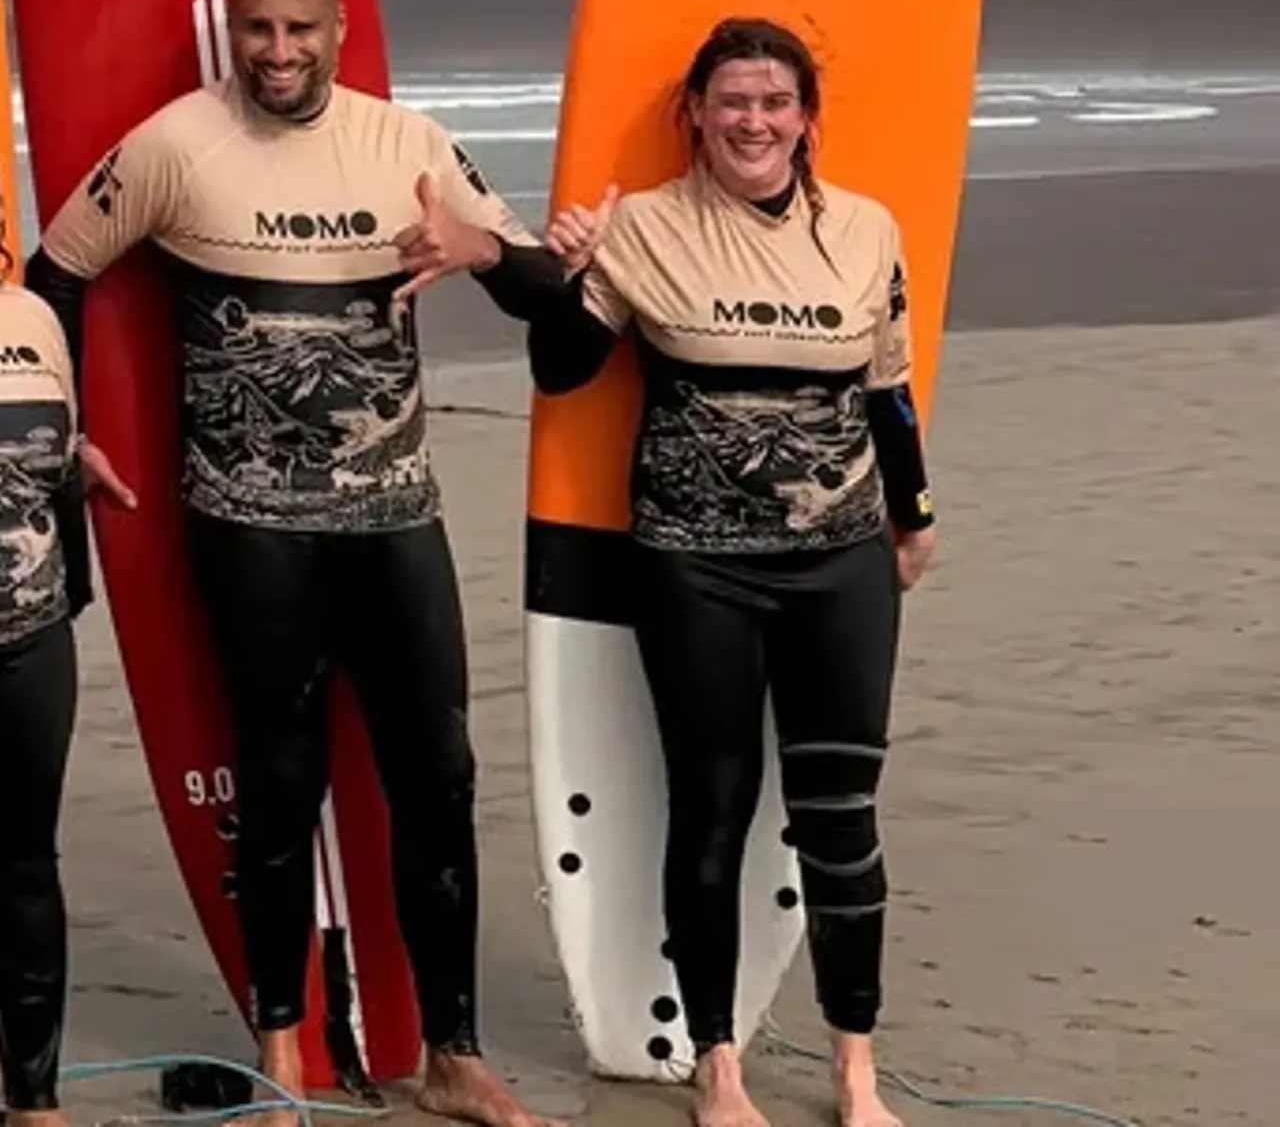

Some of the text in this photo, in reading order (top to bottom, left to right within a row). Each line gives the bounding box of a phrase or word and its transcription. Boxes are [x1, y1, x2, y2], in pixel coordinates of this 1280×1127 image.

[255, 210, 377, 239] MOMO
[713, 298, 843, 329] MOMO
[184, 766, 236, 807] 9.0
